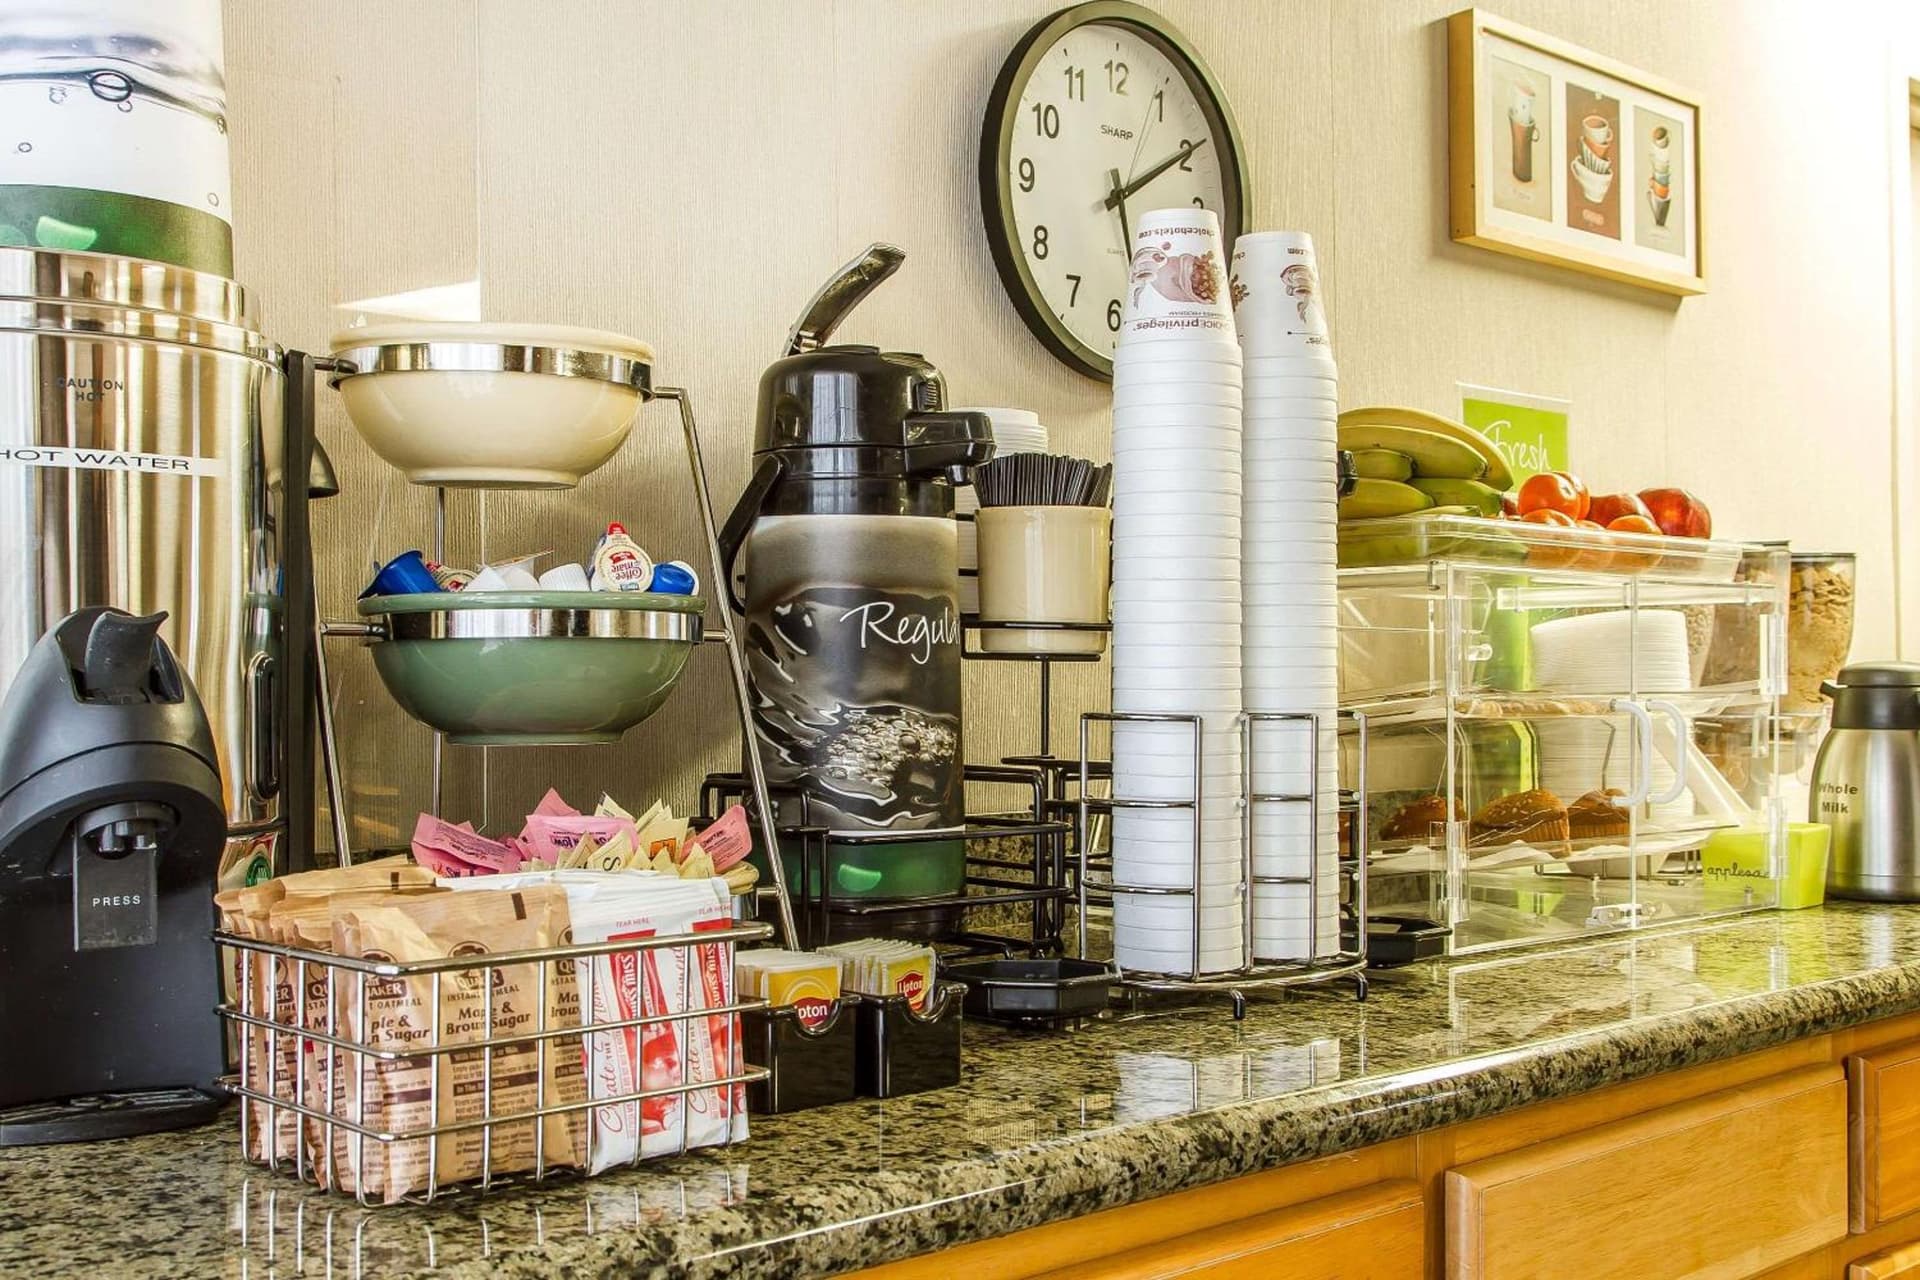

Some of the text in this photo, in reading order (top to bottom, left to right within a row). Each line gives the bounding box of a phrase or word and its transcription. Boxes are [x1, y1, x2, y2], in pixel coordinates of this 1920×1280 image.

[1064, 65, 1085, 102] 11
[1104, 59, 1130, 97] 12
[1031, 101, 1060, 139] 10
[1154, 89, 1164, 123] 1
[1100, 124, 1134, 141] SHARP
[1179, 138, 1193, 172] 2
[1018, 157, 1036, 193] 9
[1033, 224, 1049, 261] 8
[1066, 273, 1082, 308] 7
[1106, 299, 1122, 333] 6
[75, 452, 190, 471] WATER
[1481, 419, 1552, 474] Fresh
[1822, 801, 1849, 814] Milk
[92, 895, 142, 908] PRESS
[397, 1014, 412, 1028] &
[501, 1001, 515, 1014] &
[385, 1028, 431, 1044] Sugar
